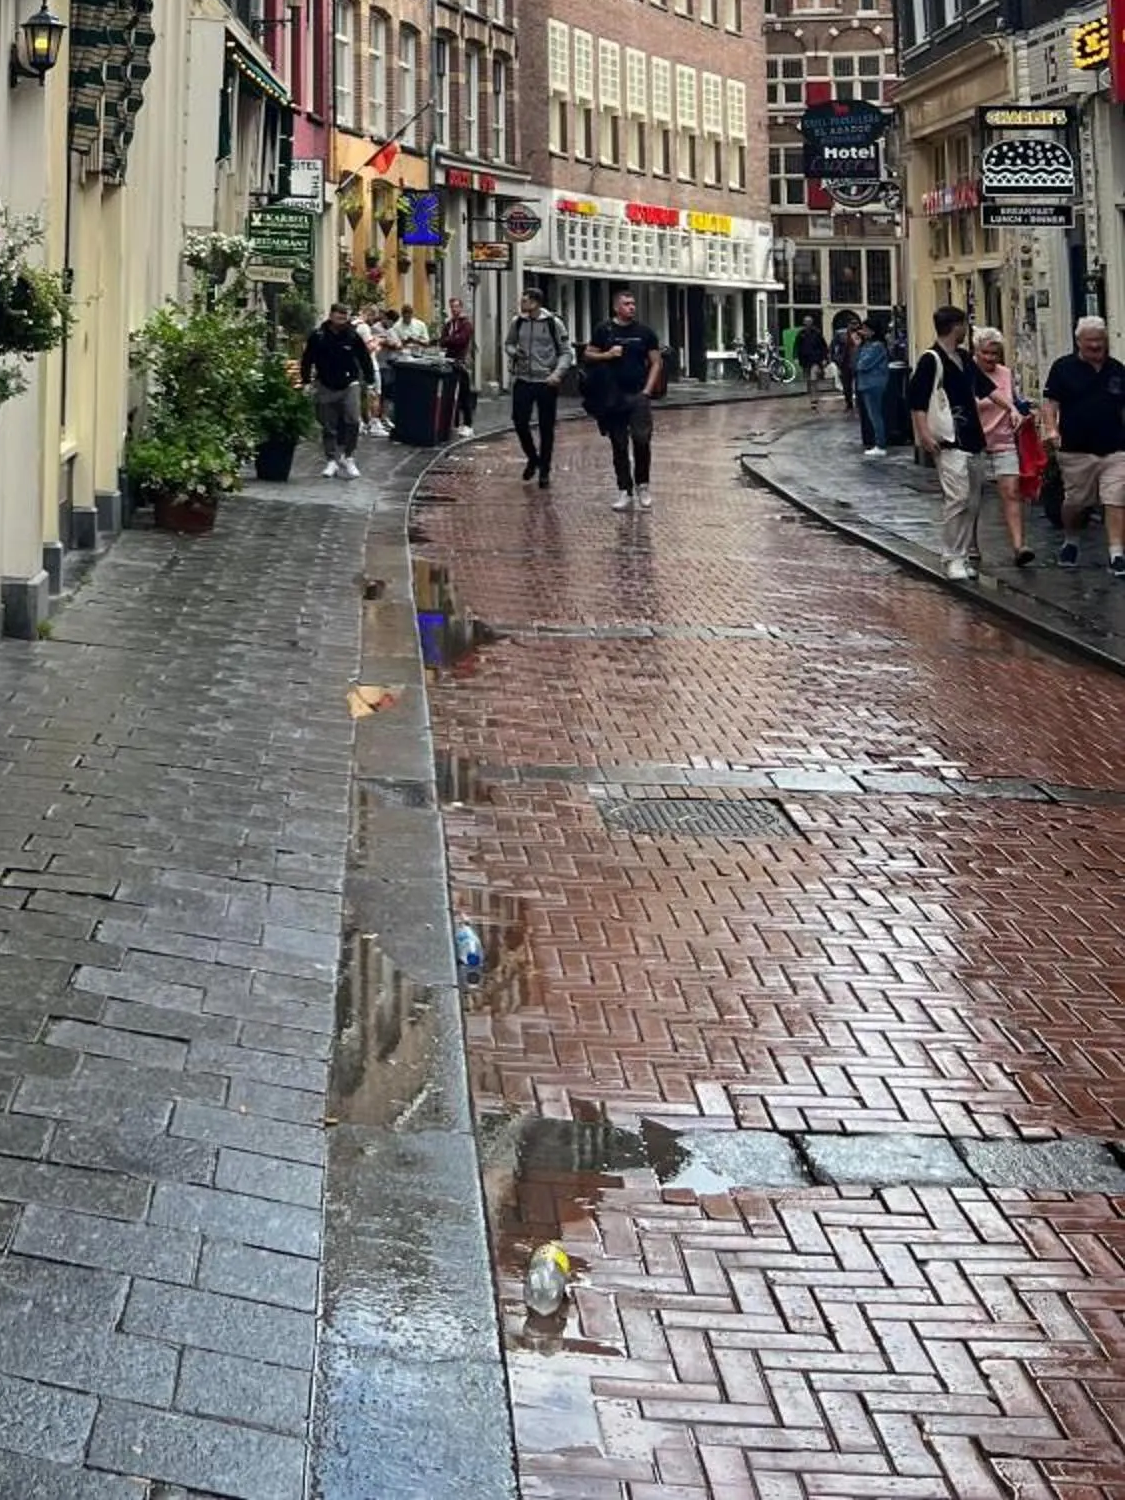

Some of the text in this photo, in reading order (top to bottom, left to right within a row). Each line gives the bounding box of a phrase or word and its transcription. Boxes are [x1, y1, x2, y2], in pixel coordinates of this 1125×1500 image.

[823, 144, 876, 161] Hotel
[989, 214, 1067, 225] LUNCH DINNER
